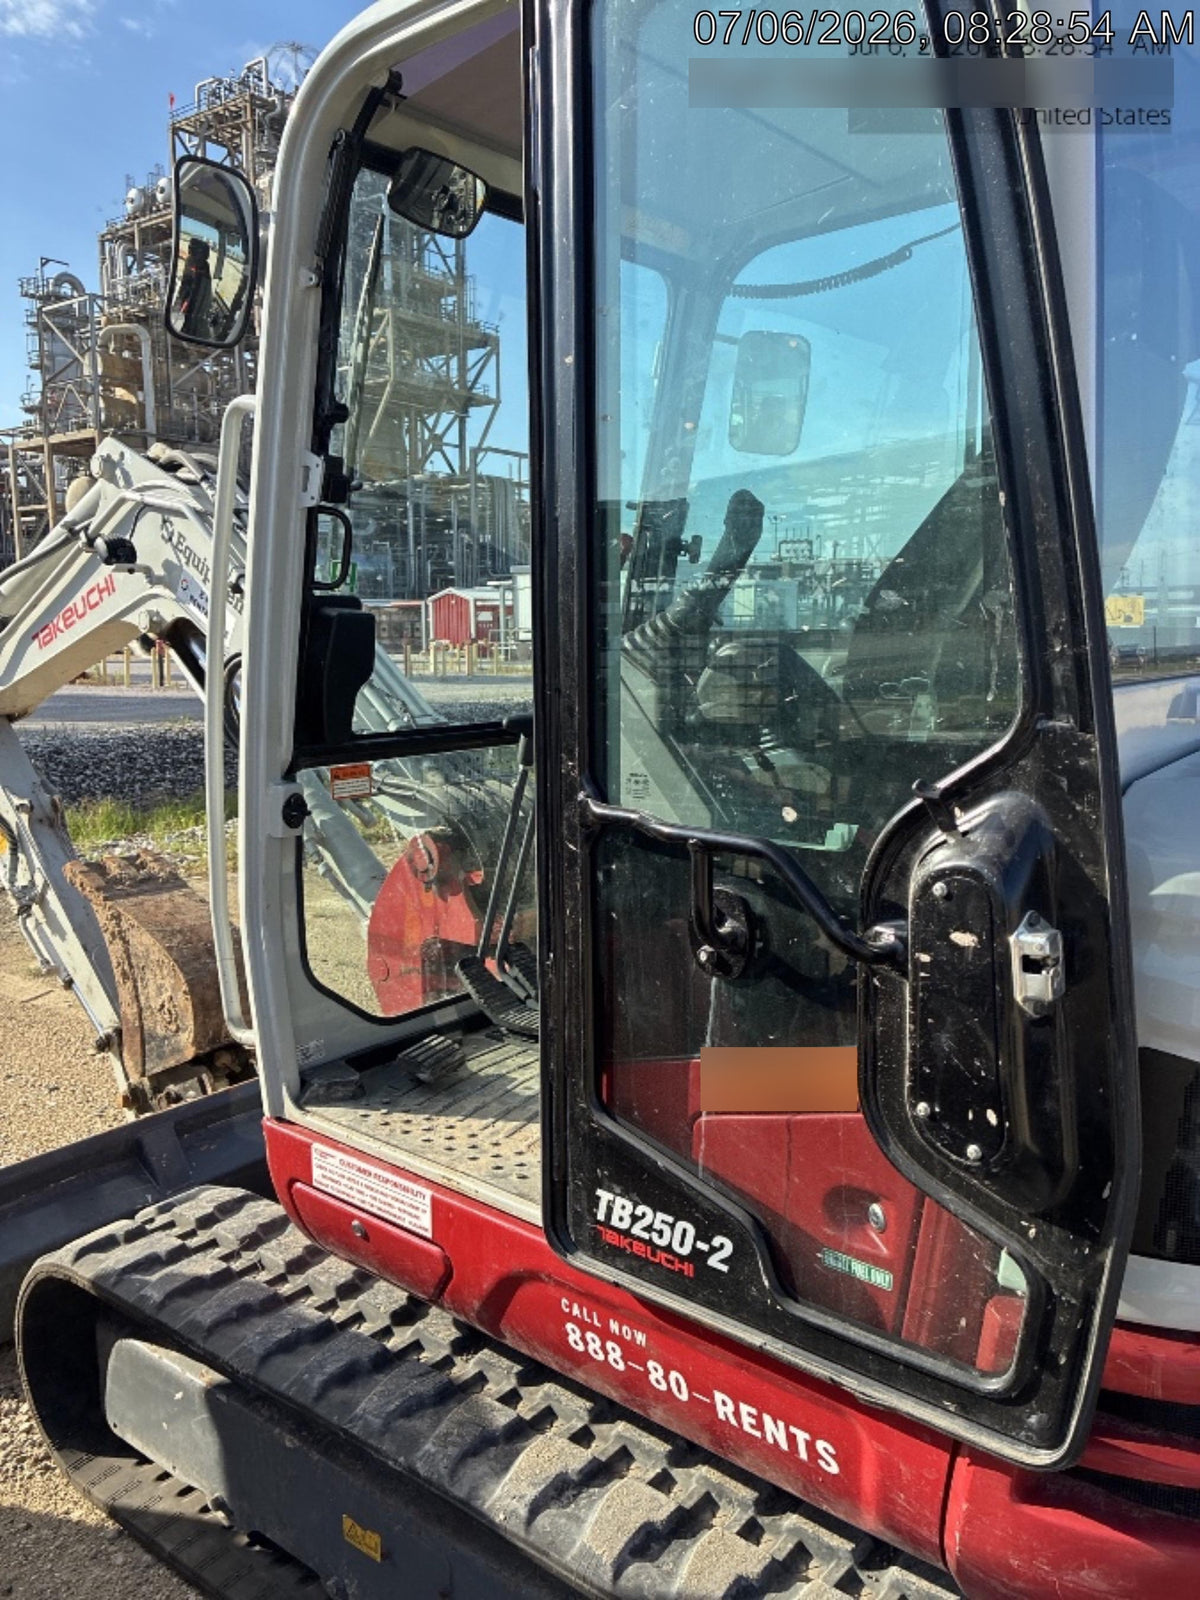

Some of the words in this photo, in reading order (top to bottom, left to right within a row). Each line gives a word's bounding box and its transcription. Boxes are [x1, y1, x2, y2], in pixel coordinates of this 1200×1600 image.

[31, 573, 117, 650] TAKEUCHI
[594, 1188, 734, 1274] TB250-2
[597, 1225, 696, 1279] TAKEUCHI
[560, 1297, 602, 1327] CALL
[608, 1318, 648, 1347] NOW
[563, 1321, 841, 1475] 888-80-RENTS
